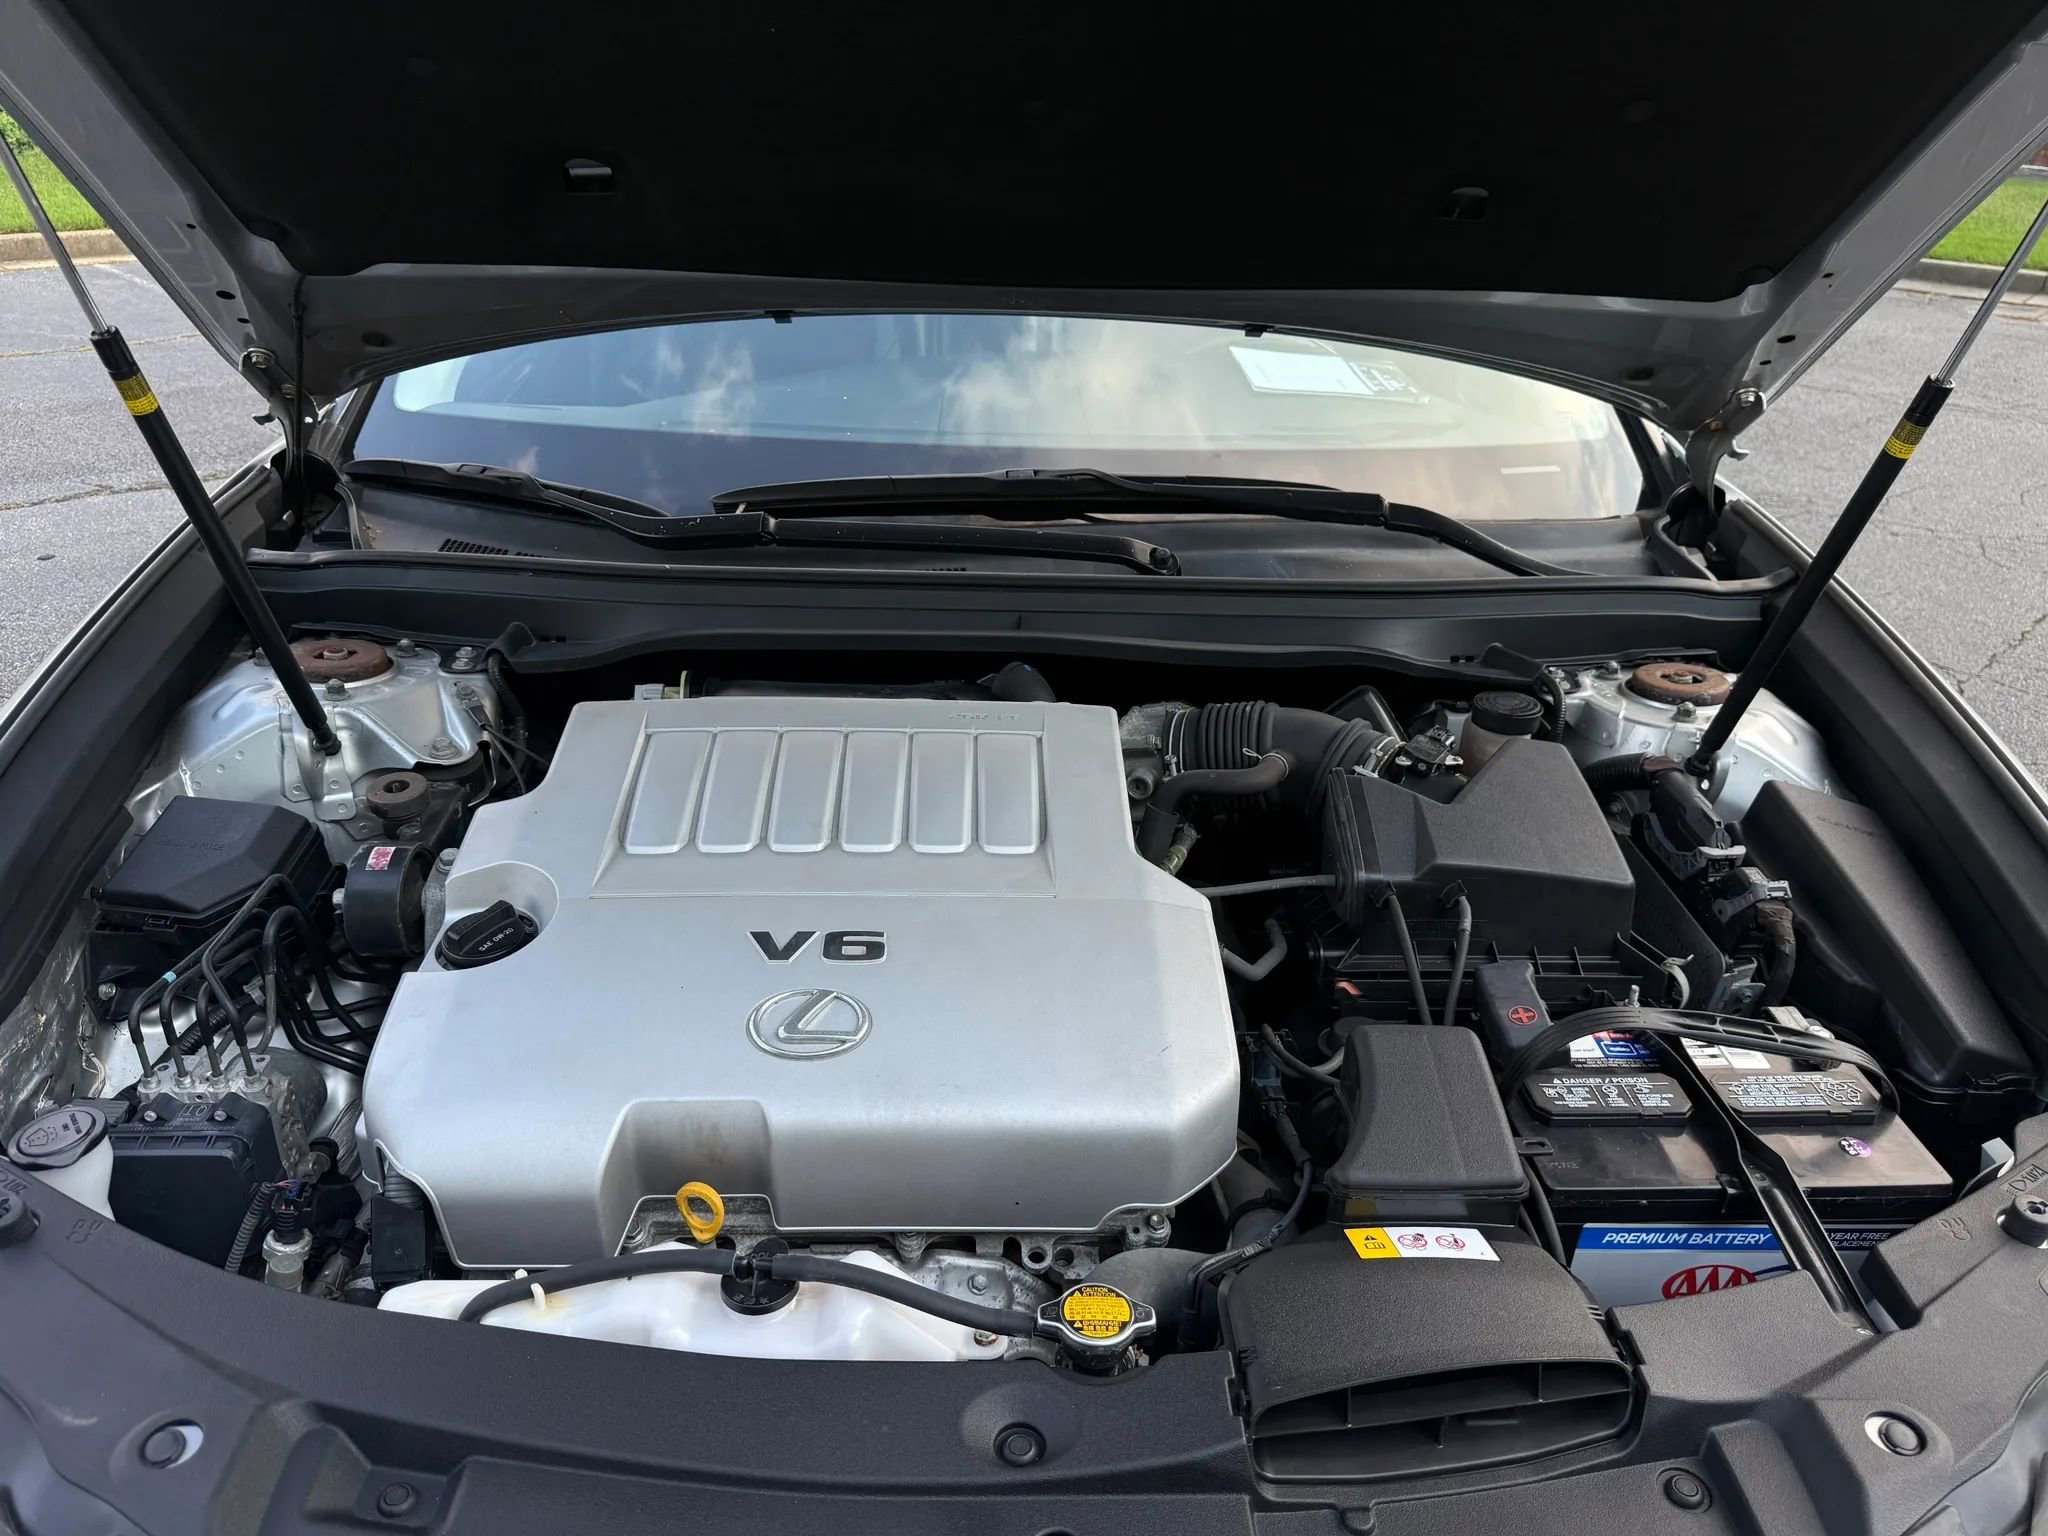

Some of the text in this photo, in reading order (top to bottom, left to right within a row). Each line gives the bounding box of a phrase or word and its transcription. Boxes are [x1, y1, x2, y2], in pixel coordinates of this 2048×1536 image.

[479, 941, 493, 952] SAE
[747, 930, 887, 964] V6
[1611, 1076, 1649, 1084] POISON
[1601, 1232, 1773, 1246] PREMIUM BATTERY
[1829, 1232, 1860, 1240] YEAR
[1860, 1232, 1891, 1240] FREE
[1662, 1265, 1757, 1300] AAA
